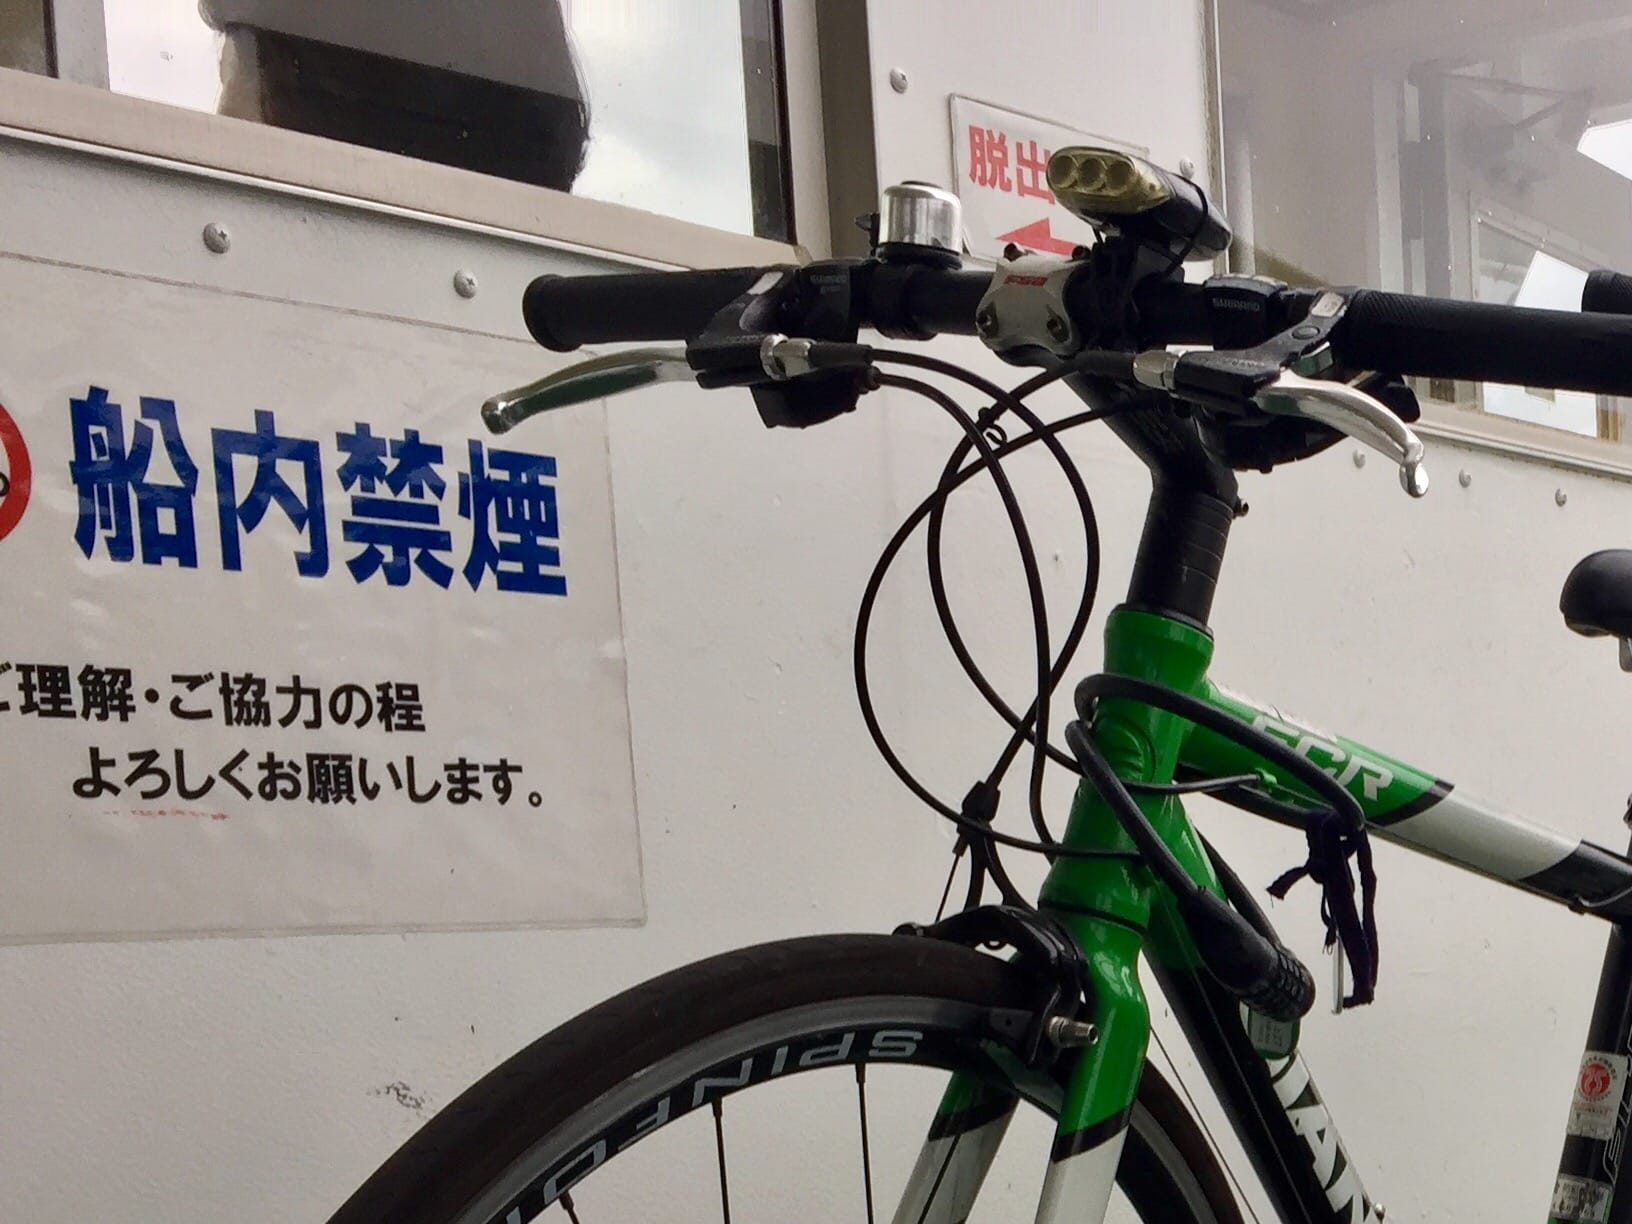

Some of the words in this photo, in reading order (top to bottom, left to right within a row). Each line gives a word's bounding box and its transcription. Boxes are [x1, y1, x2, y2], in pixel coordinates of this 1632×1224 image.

[69, 385, 568, 597] 船内禁煙
[72, 747, 543, 808] よろしくお願いします。
